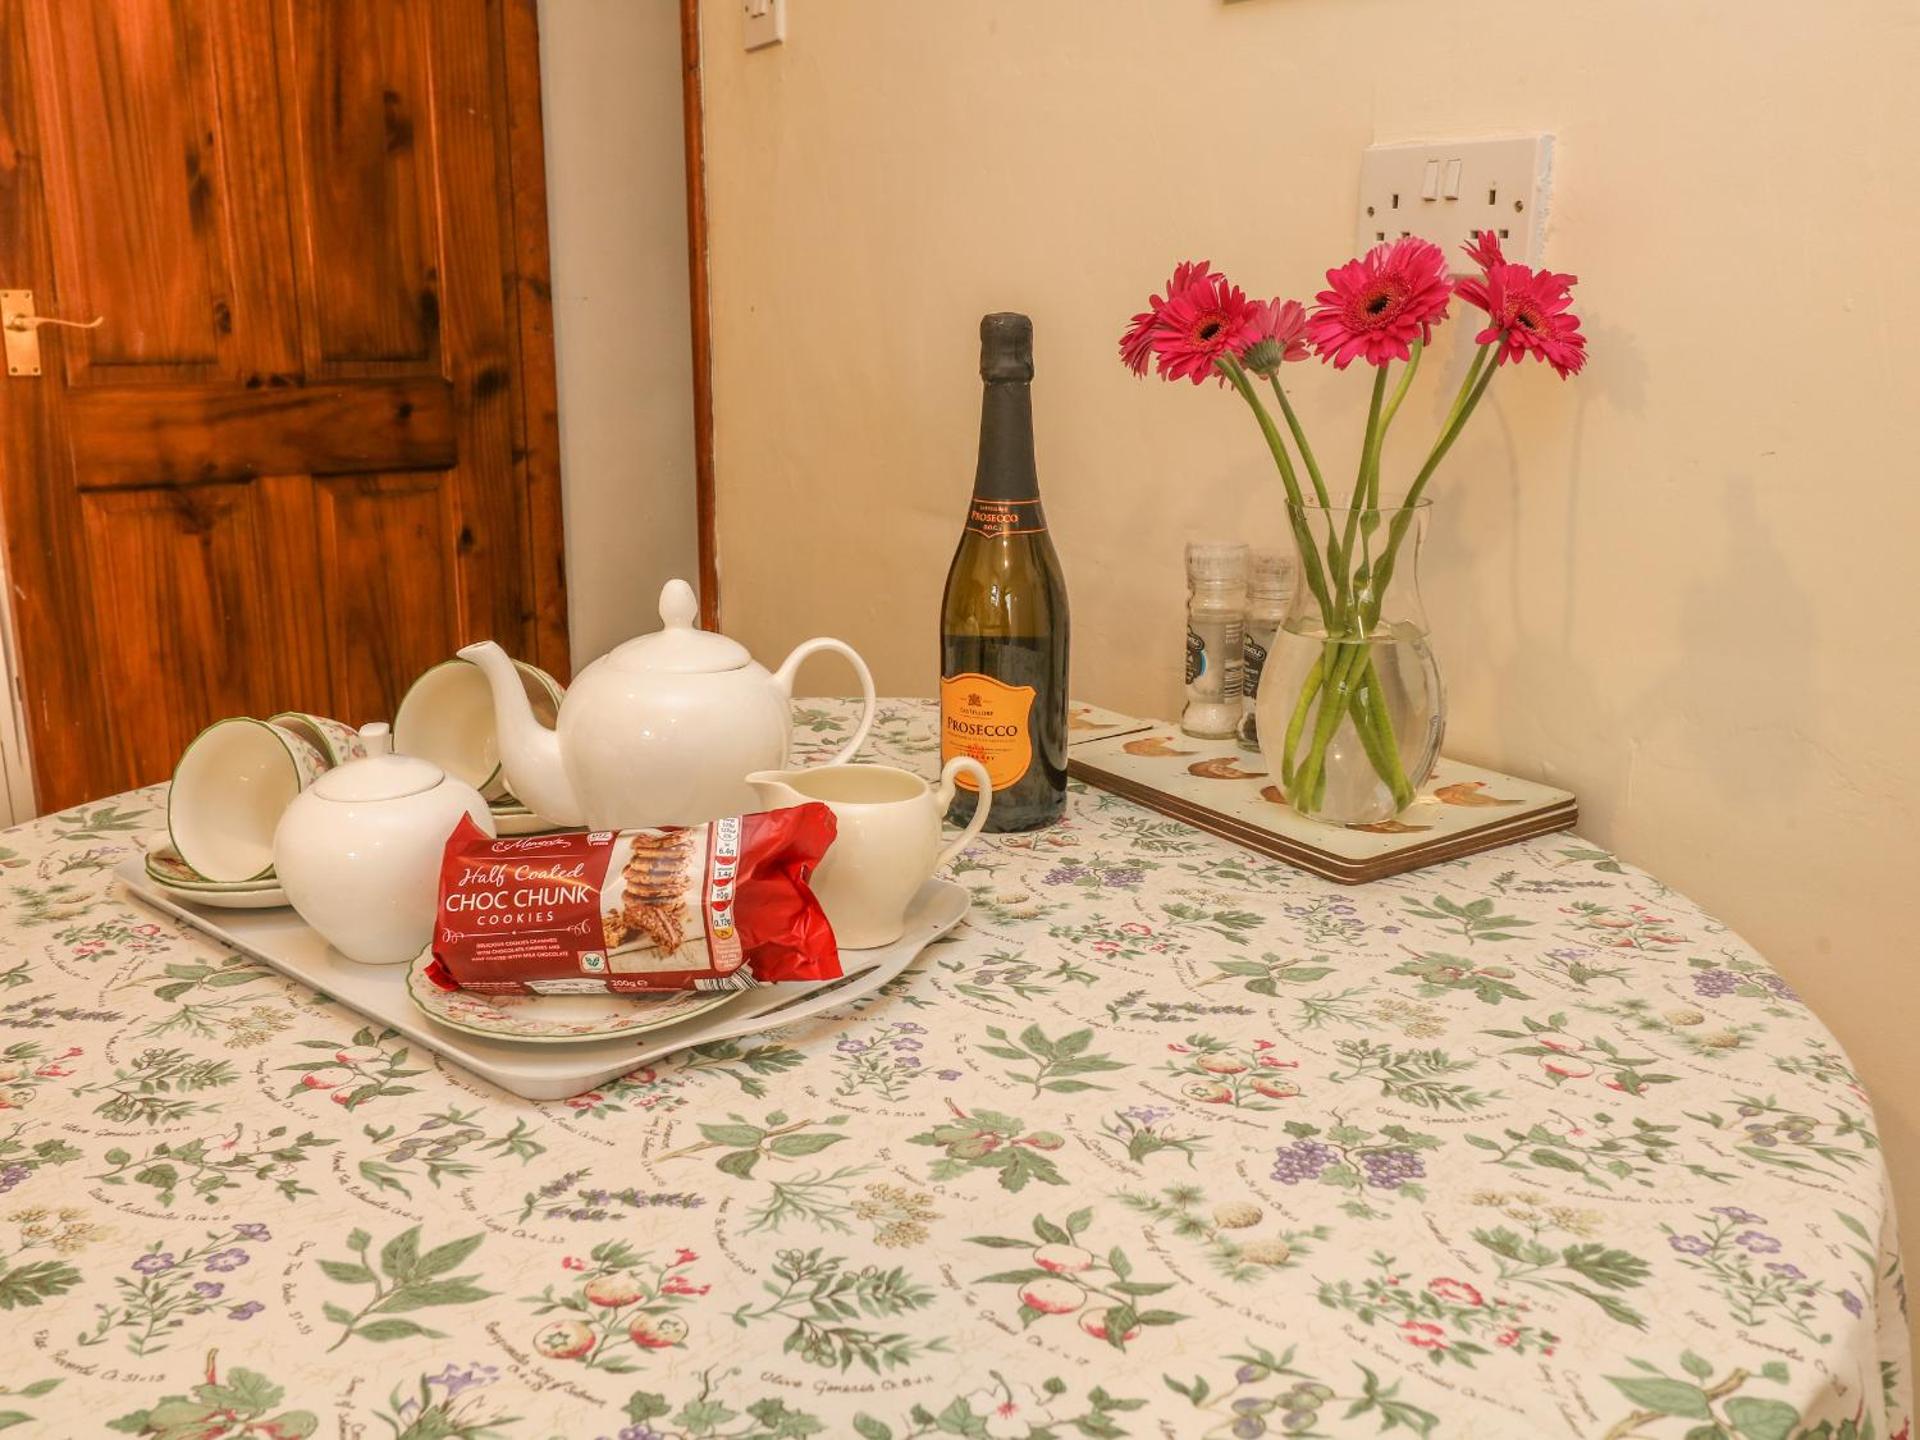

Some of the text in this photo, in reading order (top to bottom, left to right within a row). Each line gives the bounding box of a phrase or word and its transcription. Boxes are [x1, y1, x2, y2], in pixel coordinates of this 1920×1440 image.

[947, 716, 1018, 736] PROSECCO
[458, 862, 585, 887] Half Coated
[446, 885, 591, 912] CHOC CHUNK
[477, 911, 554, 926] COOKIES
[611, 980, 636, 988] 200g
